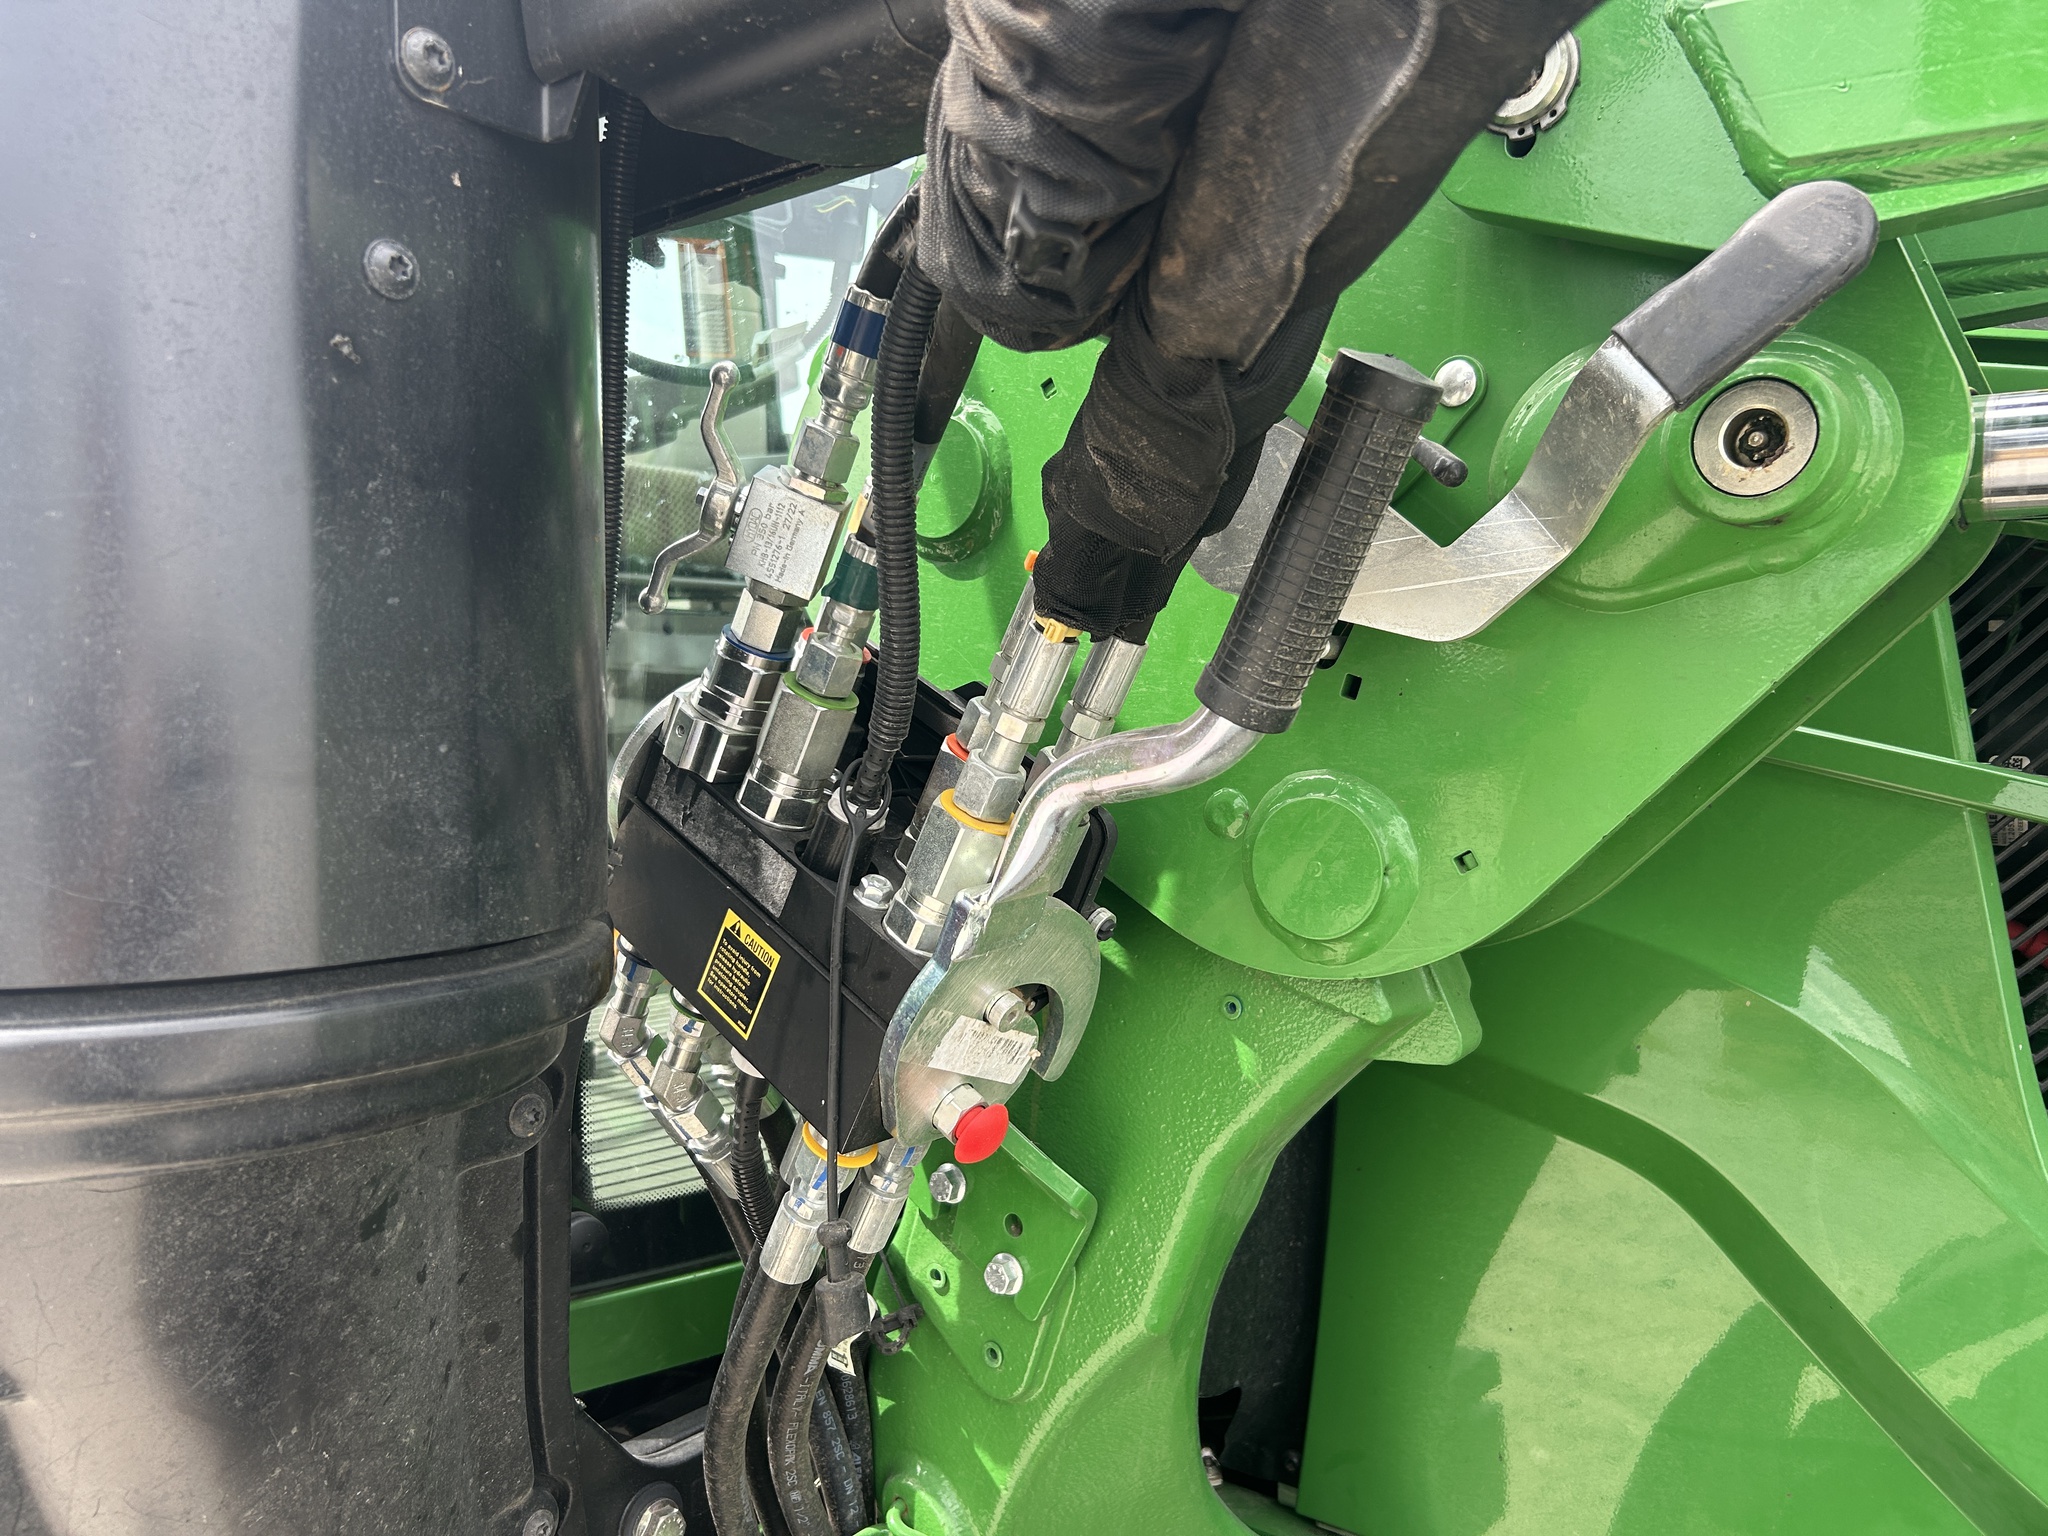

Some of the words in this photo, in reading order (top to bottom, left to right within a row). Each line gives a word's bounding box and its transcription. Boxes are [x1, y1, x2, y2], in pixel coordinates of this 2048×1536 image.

[746, 512, 761, 540] HYDAC
[751, 542, 762, 557] PN
[757, 522, 769, 541] 350
[764, 502, 775, 520] bar
[782, 502, 798, 530] 27/22
[786, 517, 804, 551] Germany
[719, 945, 735, 963] rotating
[736, 960, 750, 978] handle,
[722, 937, 728, 946] To
[728, 943, 740, 957] avoid
[738, 953, 751, 968] injury
[750, 965, 761, 978] from
[744, 933, 775, 968] CAUTION
[712, 964, 733, 987] unlatching
[733, 985, 749, 1003] coupler.
[714, 958, 732, 977] pressure
[733, 974, 746, 990] before
[717, 951, 732, 967] release
[733, 967, 750, 986] hydraulic
[710, 970, 718, 981] See
[737, 998, 752, 1015] manual
[714, 983, 738, 1010] instructions.
[840, 1375, 858, 1421] 0628613
[815, 1388, 827, 1407] EN
[822, 1409, 837, 1431] 857
[831, 1437, 846, 1461] 2SC
[842, 1479, 855, 1495] DN
[849, 1498, 860, 1515] 12
[784, 1469, 798, 1488] 2SC
